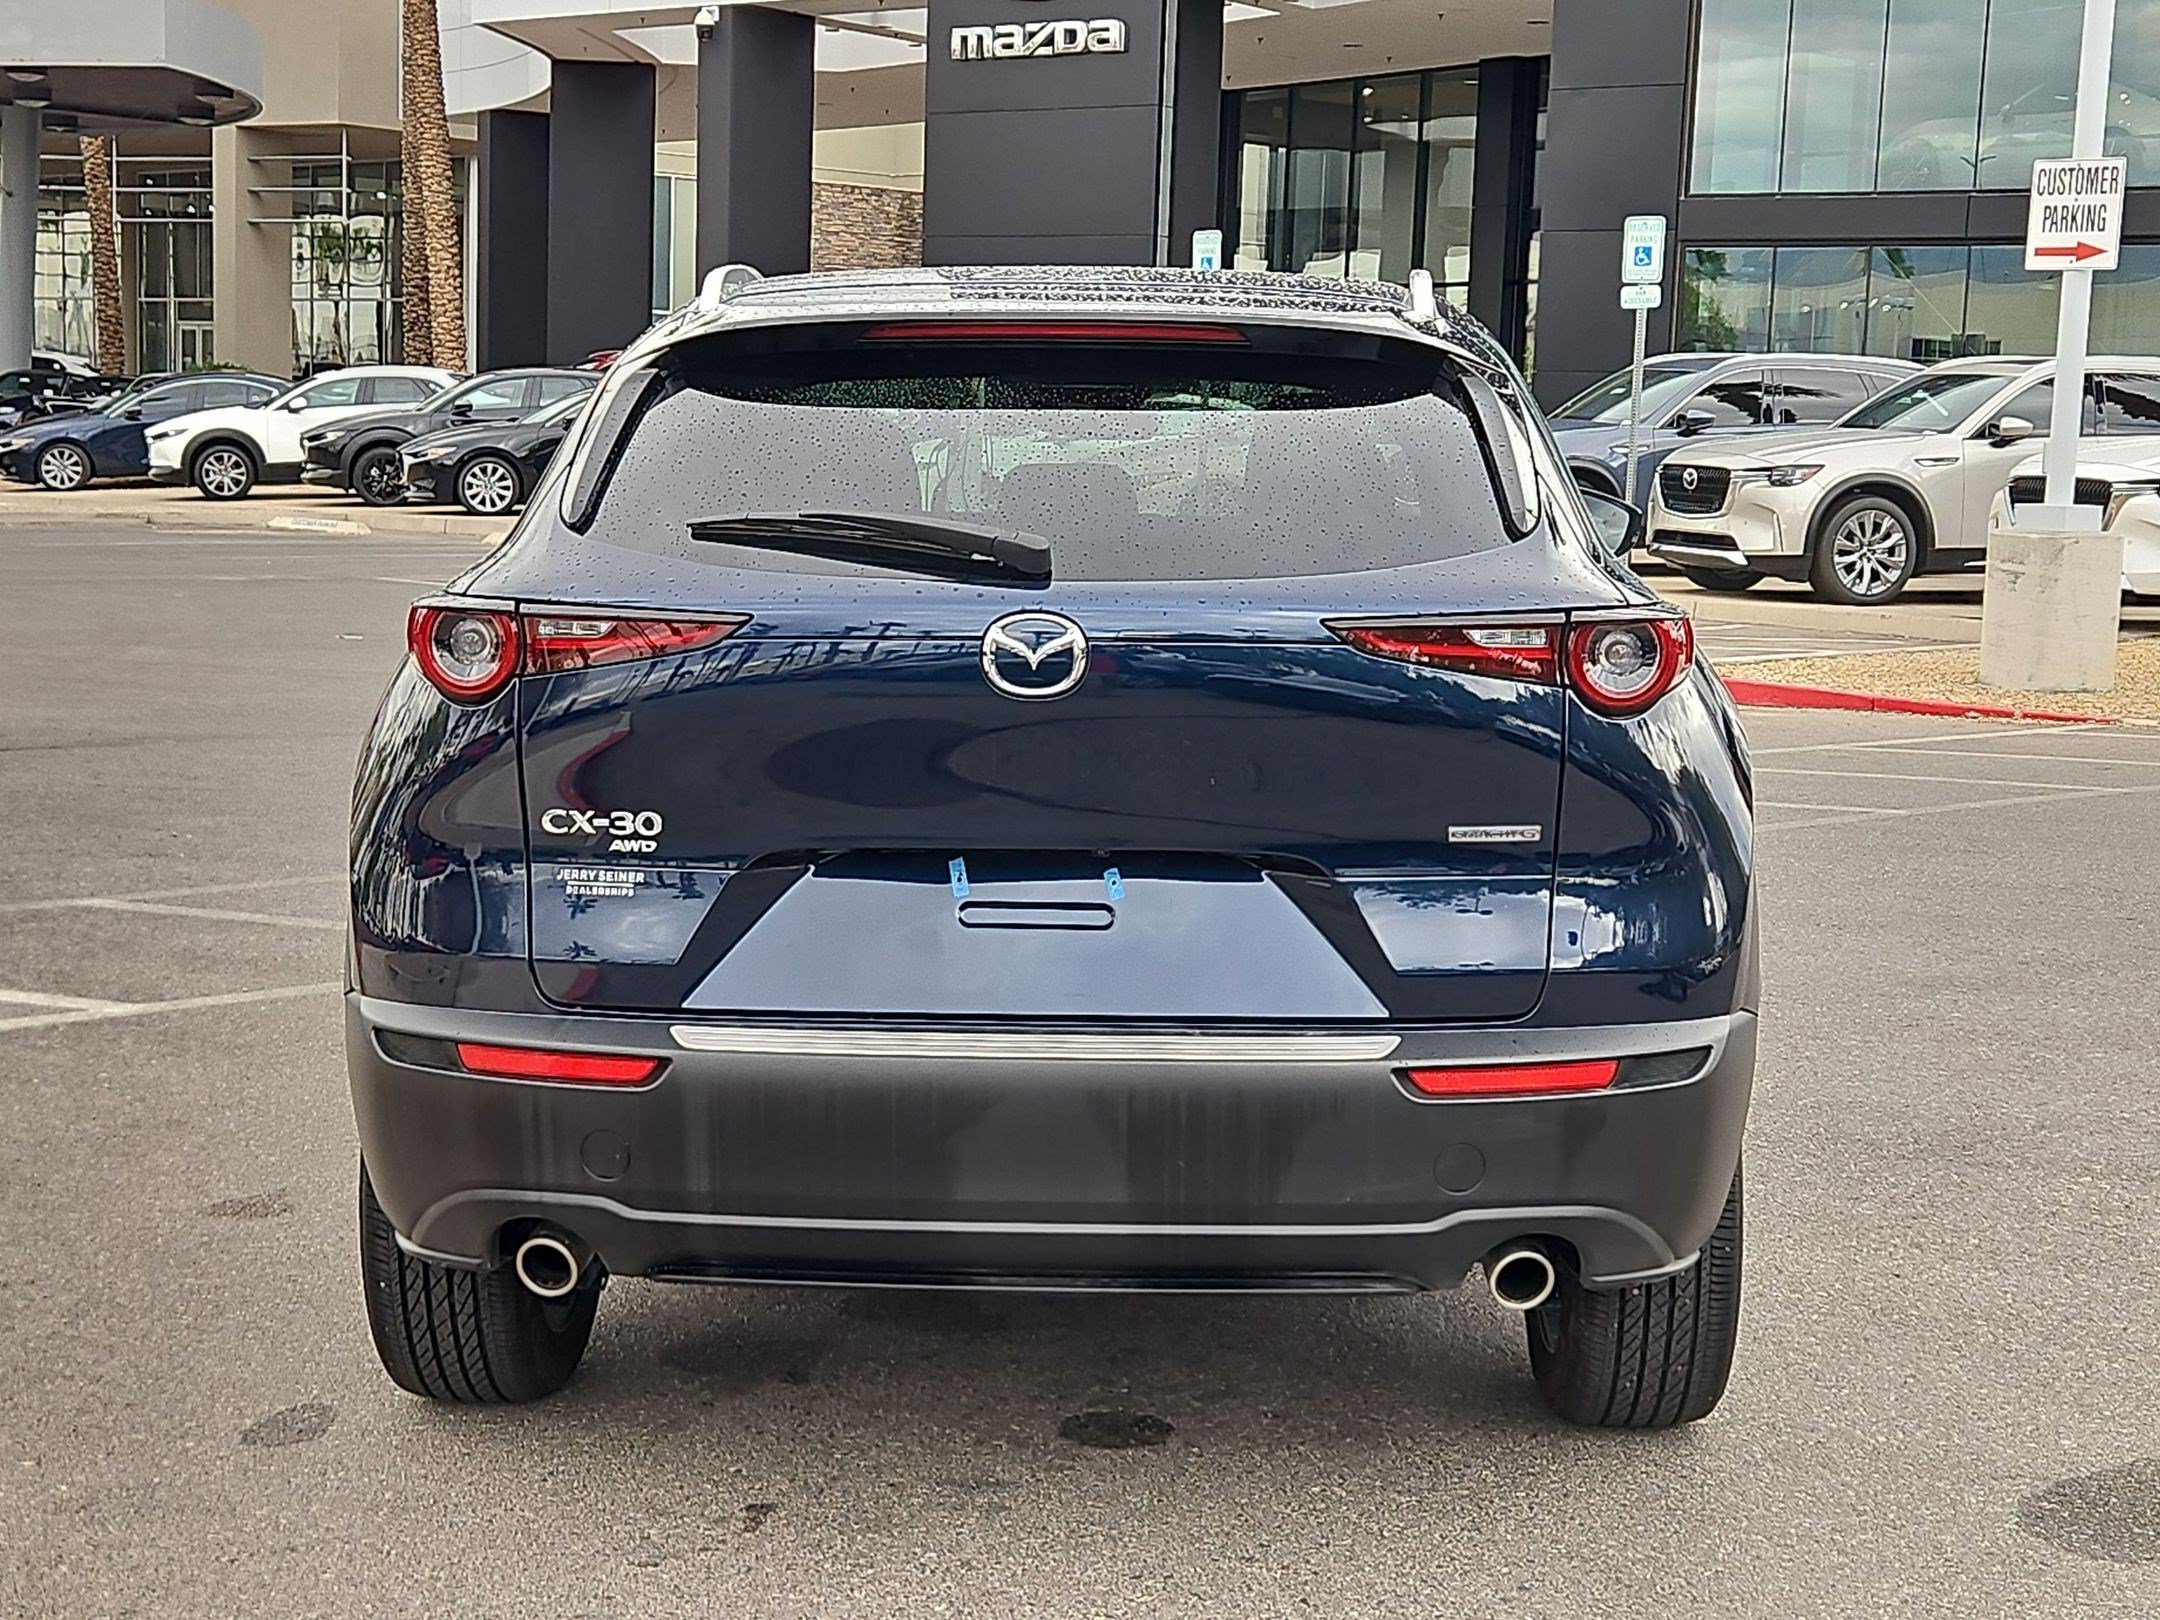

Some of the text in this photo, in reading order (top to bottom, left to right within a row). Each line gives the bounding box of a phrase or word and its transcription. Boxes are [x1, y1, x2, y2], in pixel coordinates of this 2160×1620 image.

[2036, 166, 2120, 196] CUSTOMER
[2041, 203, 2108, 233] PARKING
[541, 808, 663, 837] CX-30
[608, 839, 658, 853] AWD
[556, 868, 646, 883] JERRY SEINER
[565, 885, 635, 897] DEALERSHIPS
